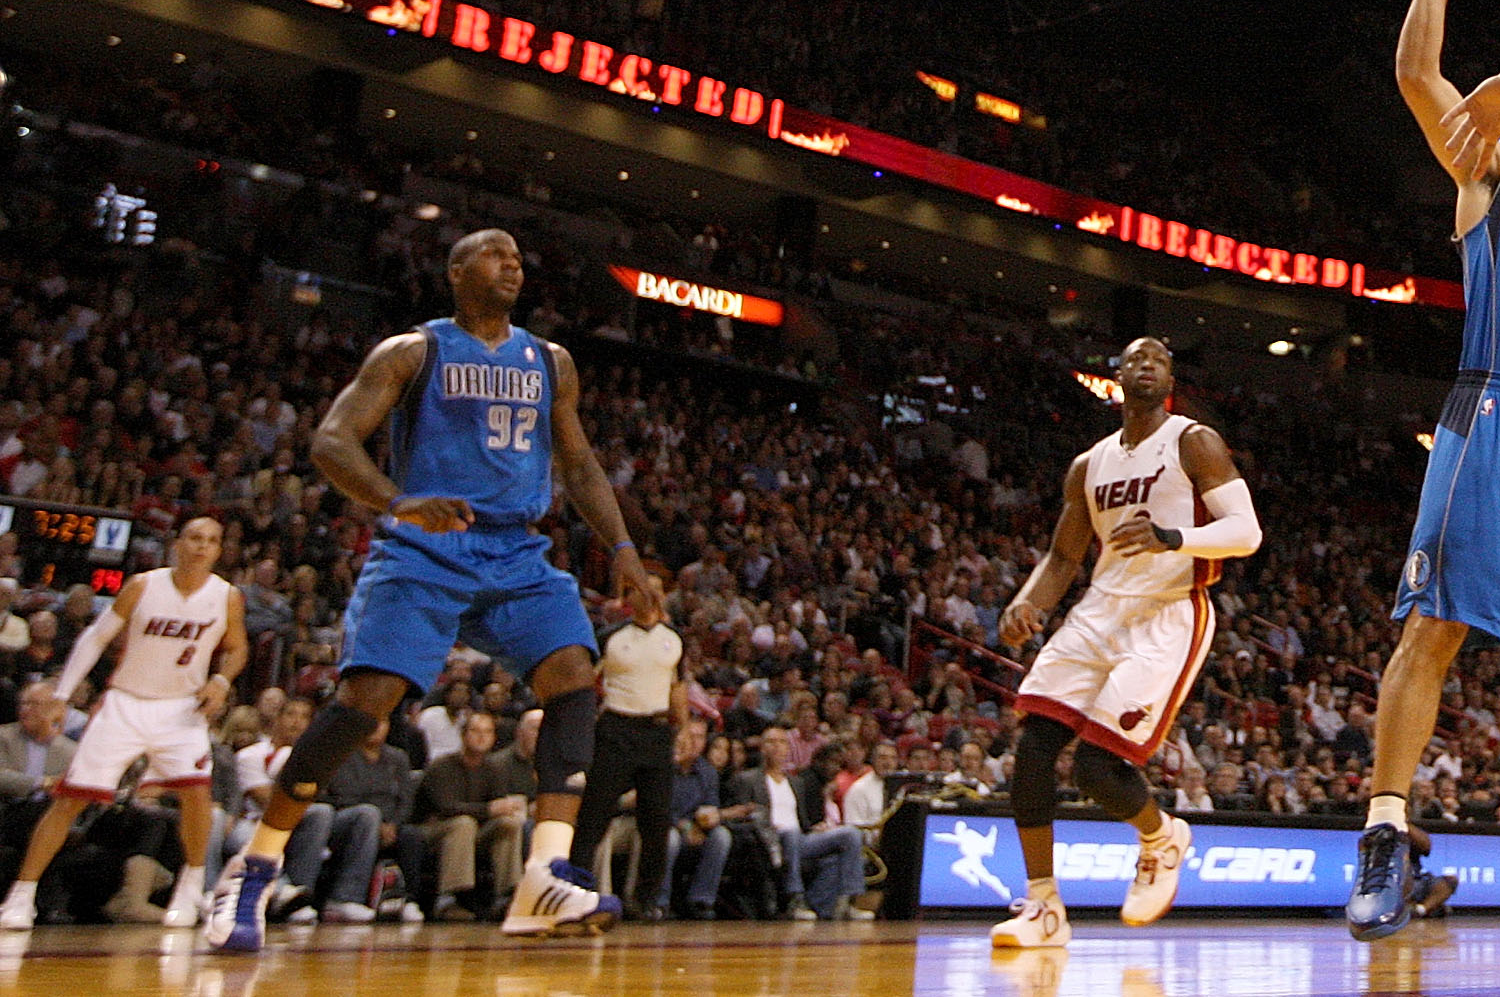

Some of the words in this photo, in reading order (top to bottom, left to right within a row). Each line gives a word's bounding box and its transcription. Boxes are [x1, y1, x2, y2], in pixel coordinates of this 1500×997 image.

[451, 2, 765, 126] REJECTED
[1137, 211, 1351, 288] REJECTED
[636, 271, 744, 319] BACARDI
[443, 362, 544, 405] DALLAS
[486, 404, 539, 452] 92
[1094, 464, 1166, 513] HEAT
[143, 617, 218, 642] HEAT
